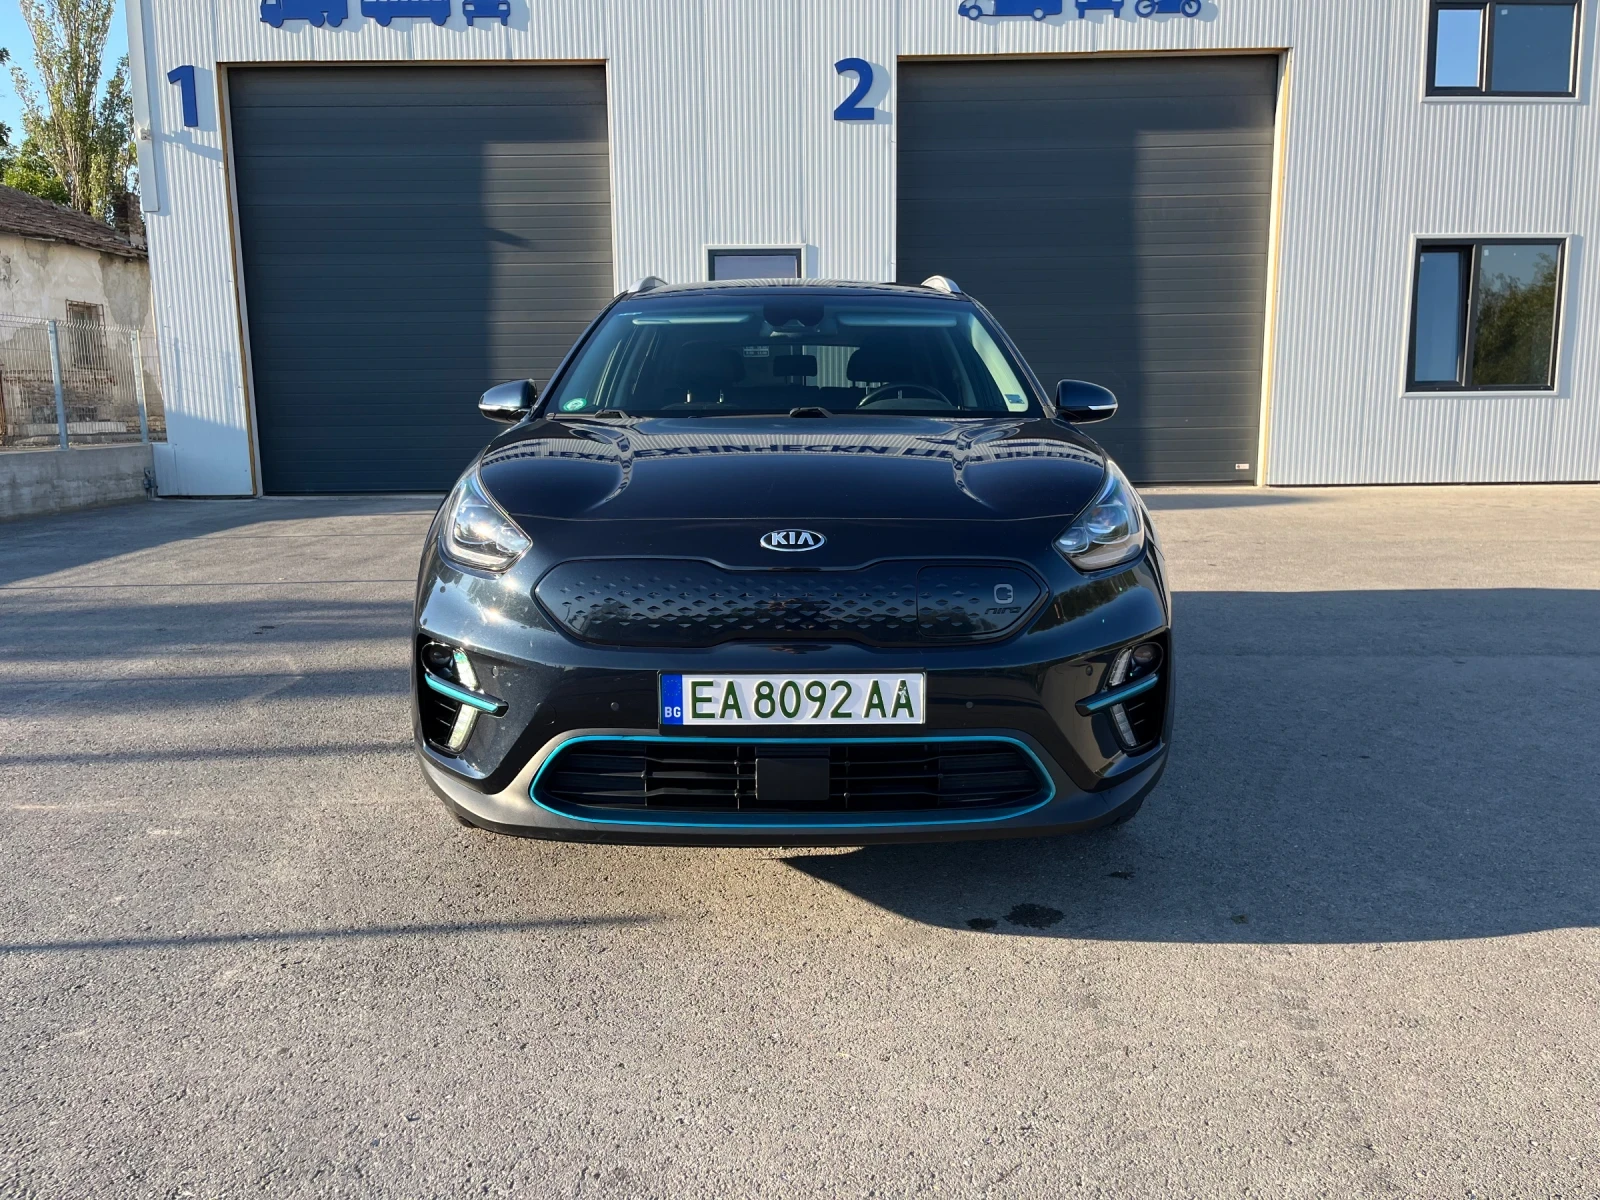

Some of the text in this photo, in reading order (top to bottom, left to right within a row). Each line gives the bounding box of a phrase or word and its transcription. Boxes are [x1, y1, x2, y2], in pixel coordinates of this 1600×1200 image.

[167, 65, 198, 127] 1
[834, 57, 875, 121] 2
[771, 531, 815, 546] KIA
[664, 706, 682, 718] BG
[690, 680, 915, 719] EA 8092 AA
